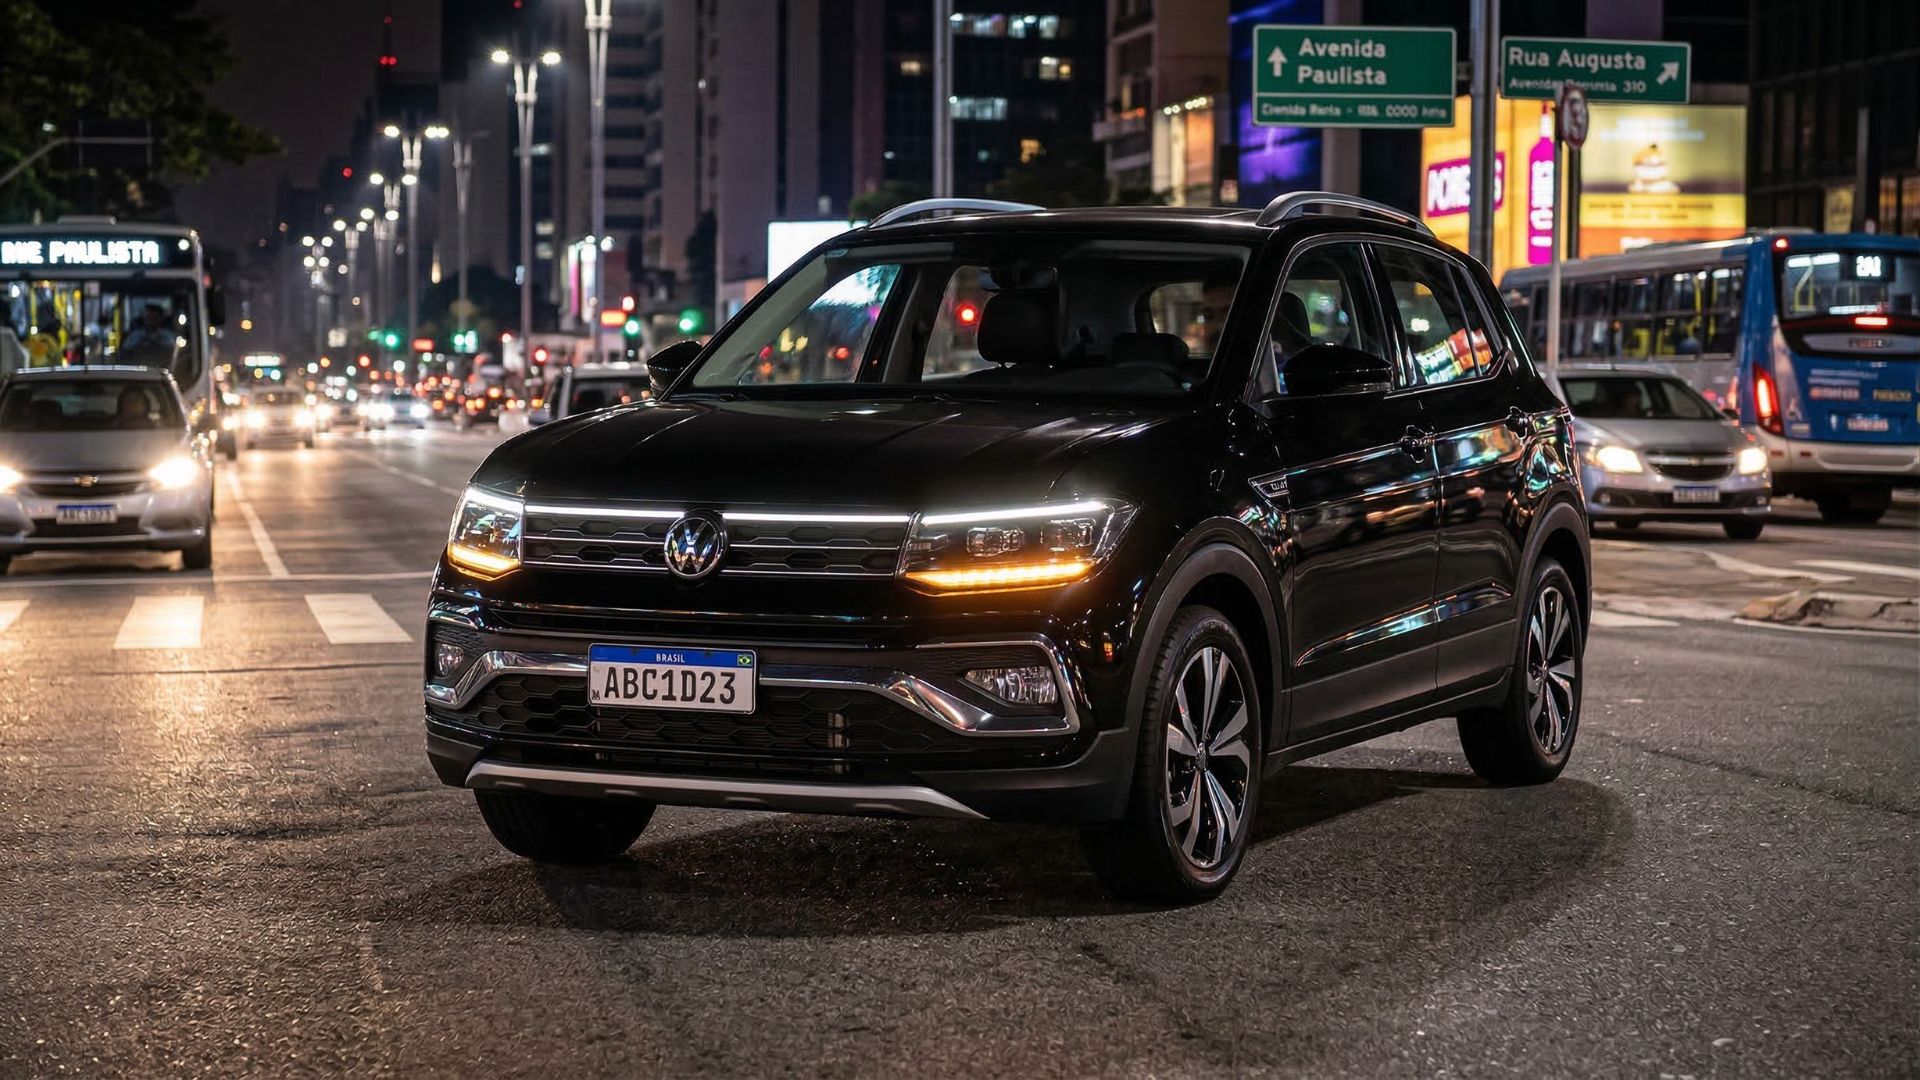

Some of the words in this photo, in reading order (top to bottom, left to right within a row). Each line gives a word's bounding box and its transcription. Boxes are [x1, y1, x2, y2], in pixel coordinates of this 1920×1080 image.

[1299, 37, 1387, 58] Avenida
[1508, 46, 1550, 66] Rua
[1557, 49, 1647, 74] Augusta
[1297, 65, 1388, 85] Paulista
[49, 240, 160, 264] PAULISTA
[655, 653, 686, 664] BRASIL
[604, 666, 736, 705] ABC1D23
